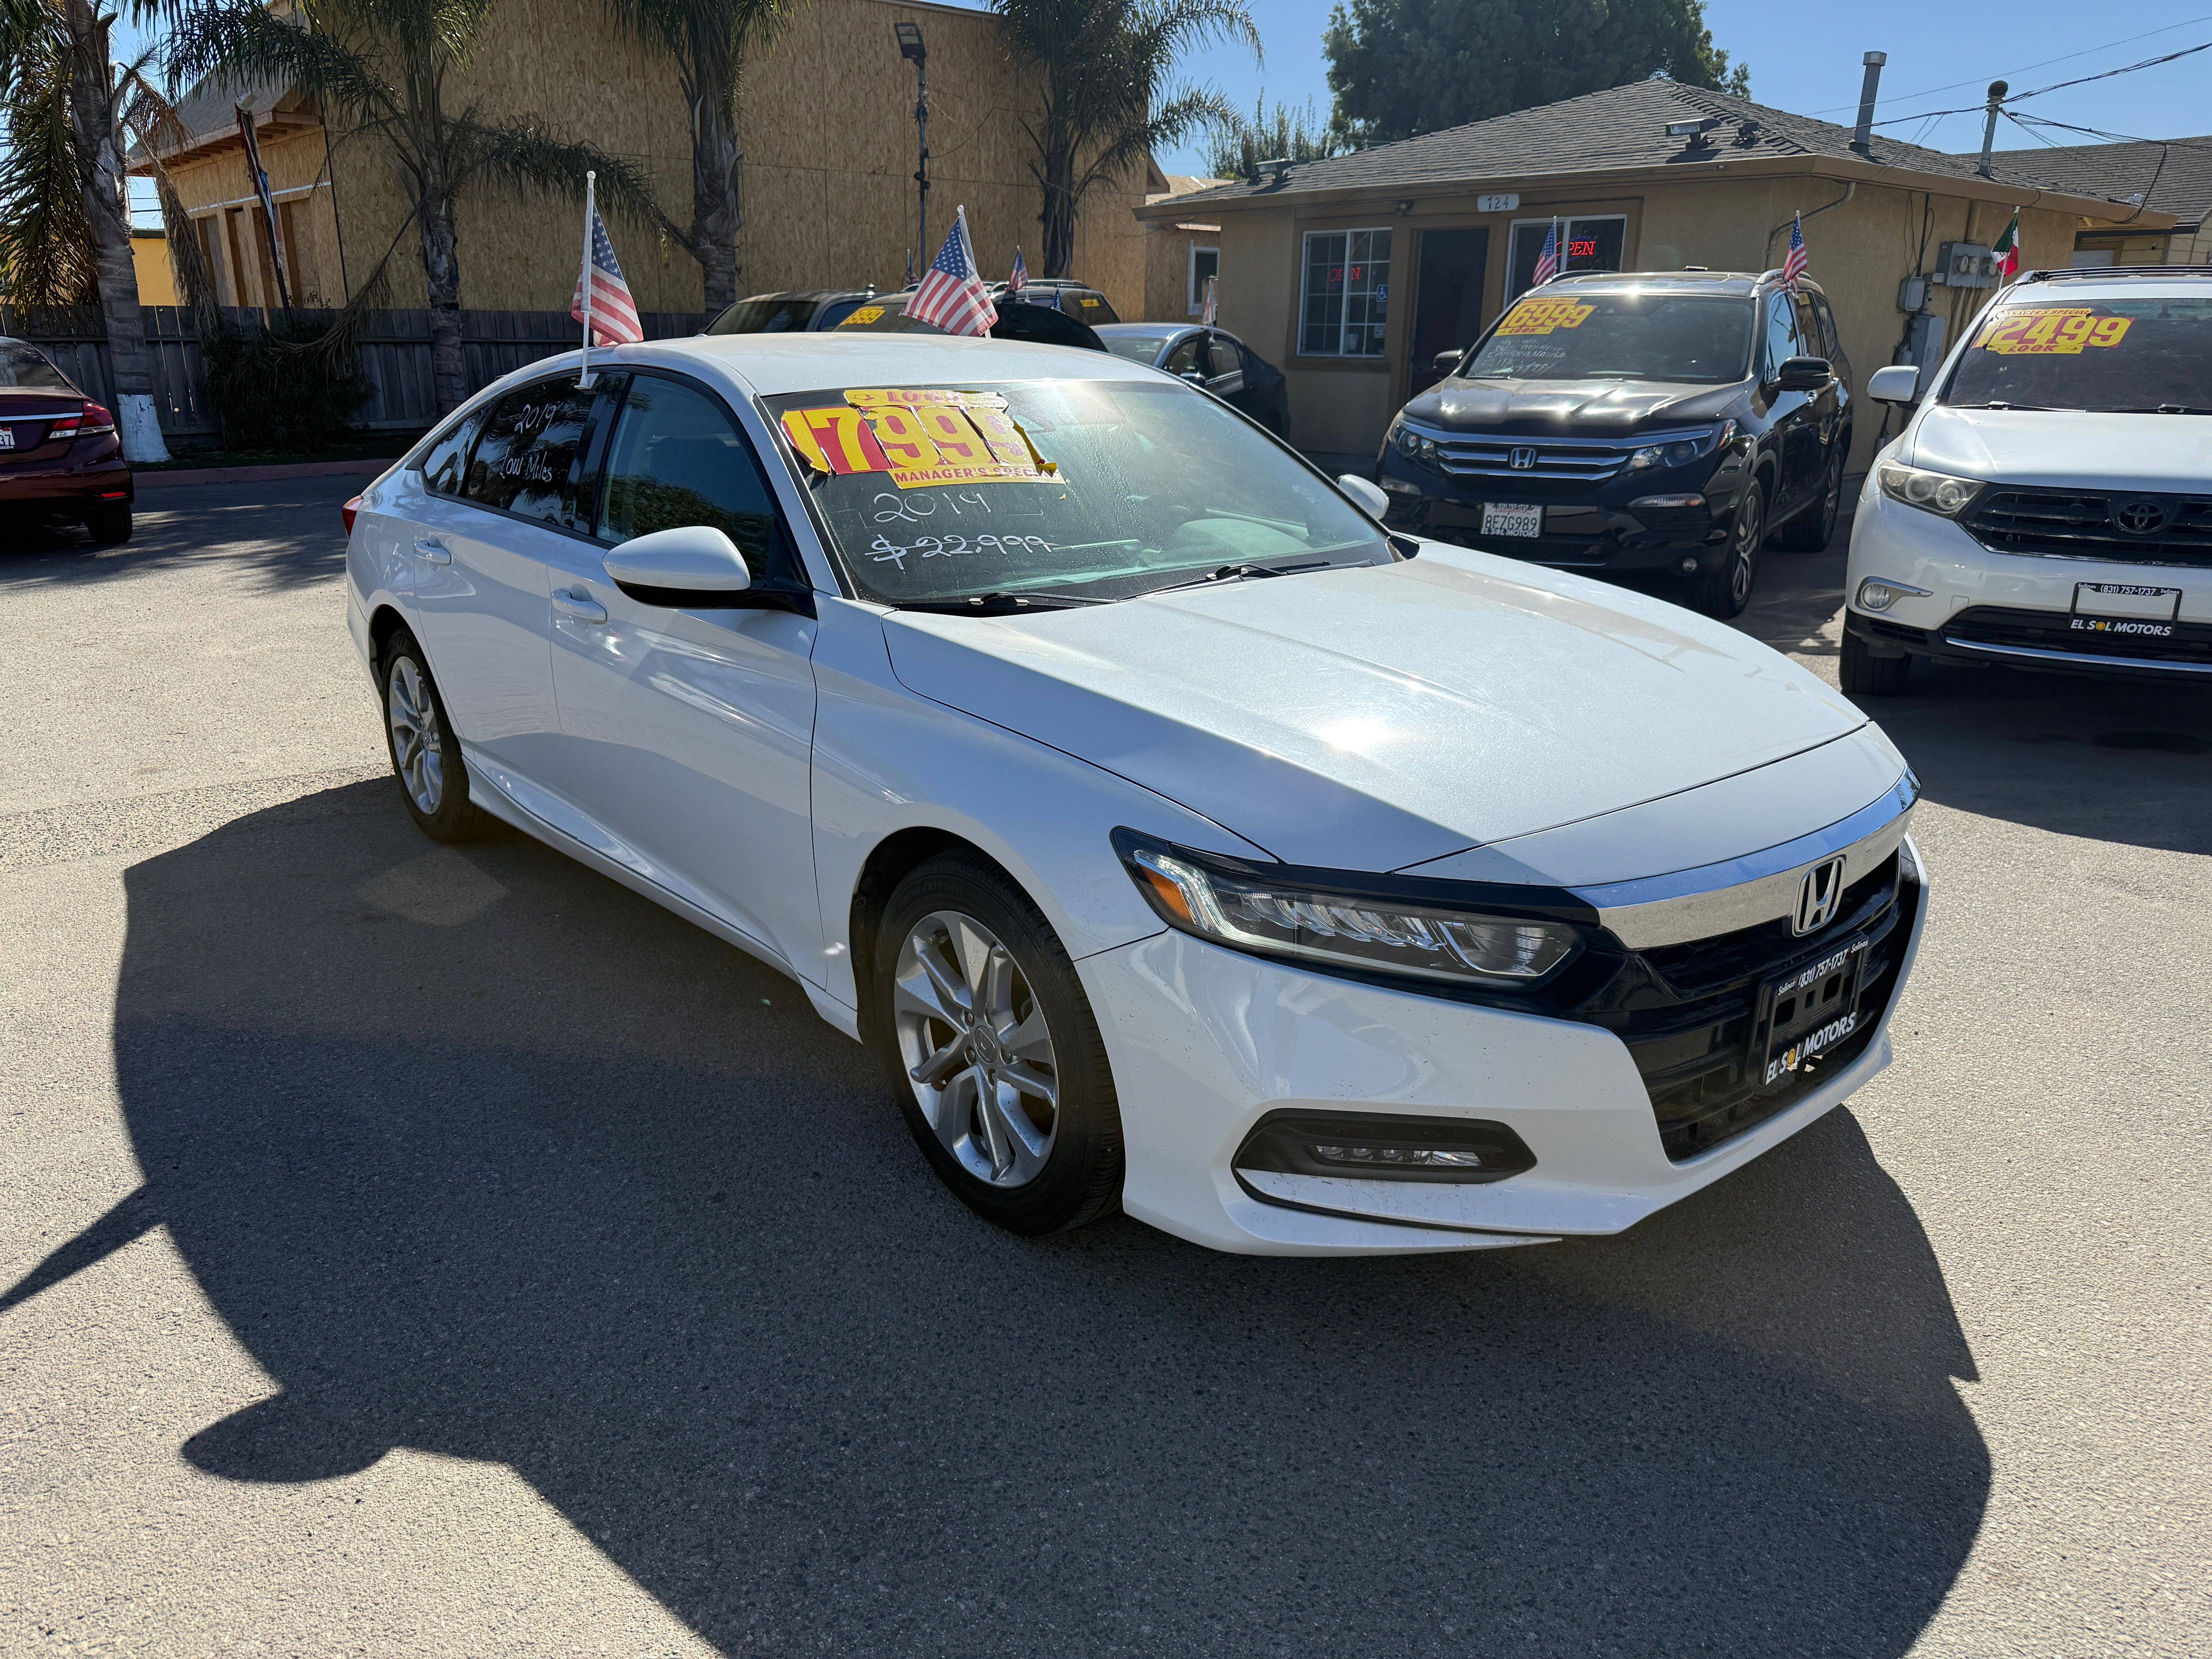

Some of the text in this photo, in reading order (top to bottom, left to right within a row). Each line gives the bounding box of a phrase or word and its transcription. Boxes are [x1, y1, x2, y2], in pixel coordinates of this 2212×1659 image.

[1487, 196, 1509, 210] 124
[1329, 267, 1362, 282] OPN
[514, 404, 557, 433] 2019
[781, 405, 1036, 474] 17999
[895, 467, 988, 483] MANAGER'S
[1506, 529, 1540, 538] MOTORS
[2100, 584, 2119, 593] (831)
[2120, 586, 2156, 596] 757-1737
[2070, 619, 2172, 636] EL SOL MOTORS
[1778, 939, 1869, 996] Salinas (831) 757-1737 Salinas
[1765, 1012, 1856, 1085] EL SOL MOTORS
